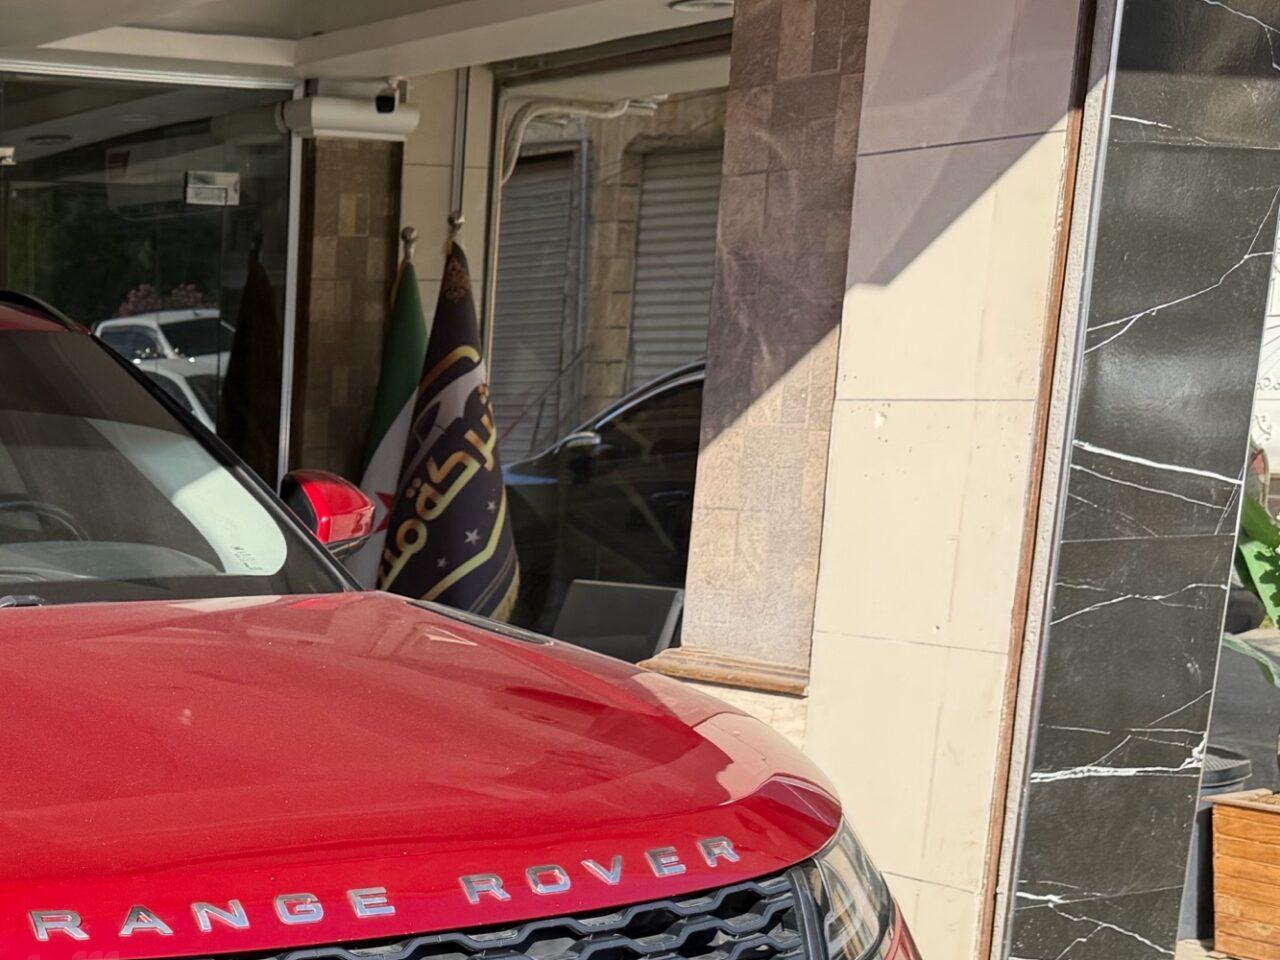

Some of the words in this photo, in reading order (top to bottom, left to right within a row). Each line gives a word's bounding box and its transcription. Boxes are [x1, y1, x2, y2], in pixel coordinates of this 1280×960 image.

[405, 384, 497, 521] شركة
[28, 885, 397, 942] RANGE
[458, 835, 741, 905] ROVER
